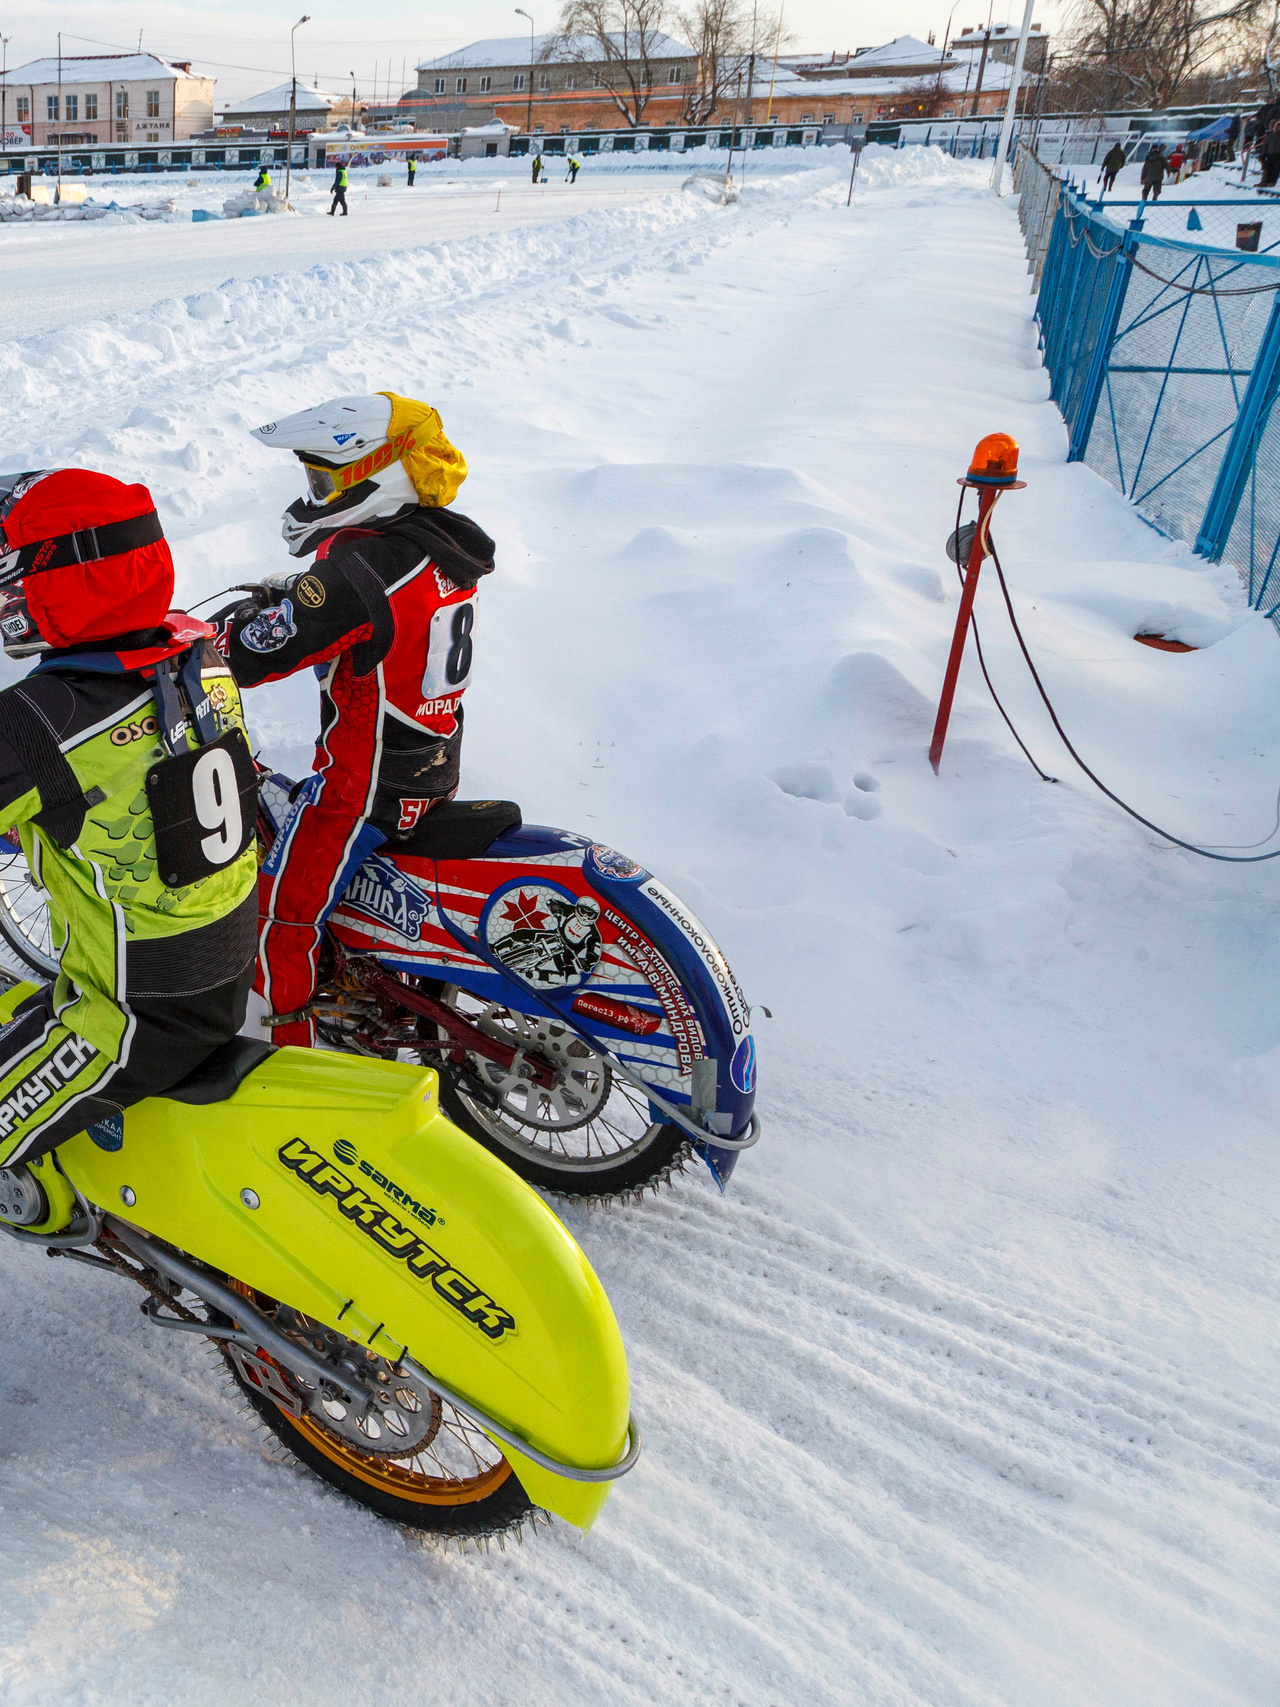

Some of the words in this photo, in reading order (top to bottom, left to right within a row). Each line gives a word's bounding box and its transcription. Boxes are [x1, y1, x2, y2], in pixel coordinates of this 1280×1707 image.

[135, 122, 170, 131] ДЖУЛИЯ
[338, 428, 416, 487] 100%
[29, 539, 54, 574] VISTA
[300, 580, 322, 605] OSO
[3, 619, 26, 634] SHOEI
[445, 602, 474, 686] 8
[191, 747, 243, 865] 9
[647, 886, 743, 1036] Оптиковолоконные
[604, 909, 639, 942] ЦЕНТР
[639, 938, 691, 1018] ТЕХНИЧЕСКИХ
[685, 1018, 704, 1061] ВИДОВ
[577, 999, 629, 1024] Пегас13.рф
[383, 1190, 408, 1212] матрасы
[277, 1136, 516, 1340] ИРКУТСК
